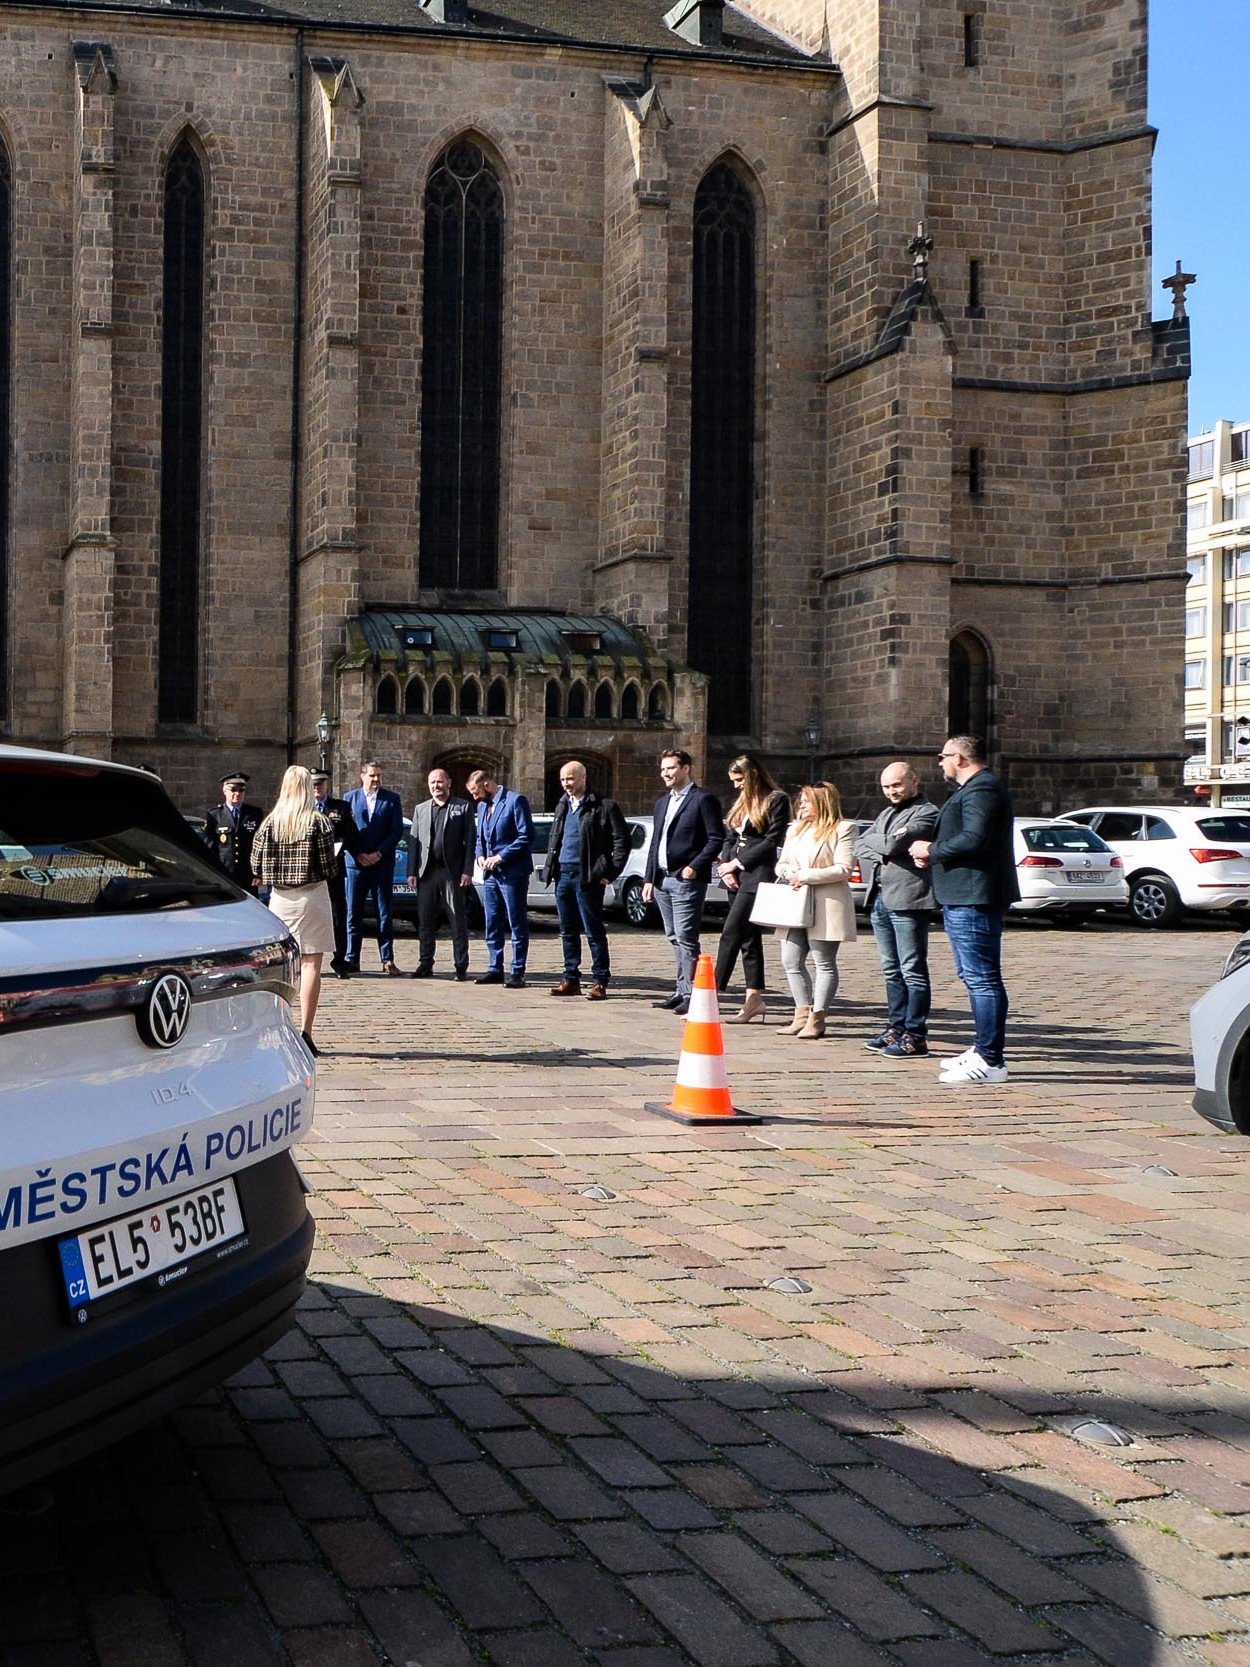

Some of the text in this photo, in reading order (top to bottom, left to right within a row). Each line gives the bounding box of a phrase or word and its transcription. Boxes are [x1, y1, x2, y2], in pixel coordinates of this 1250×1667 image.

[151, 1081, 194, 1105] ID.4
[205, 1098, 302, 1170] POLICIE
[88, 1187, 226, 1289] EL5 53BF
[69, 1279, 86, 1298] CZ
